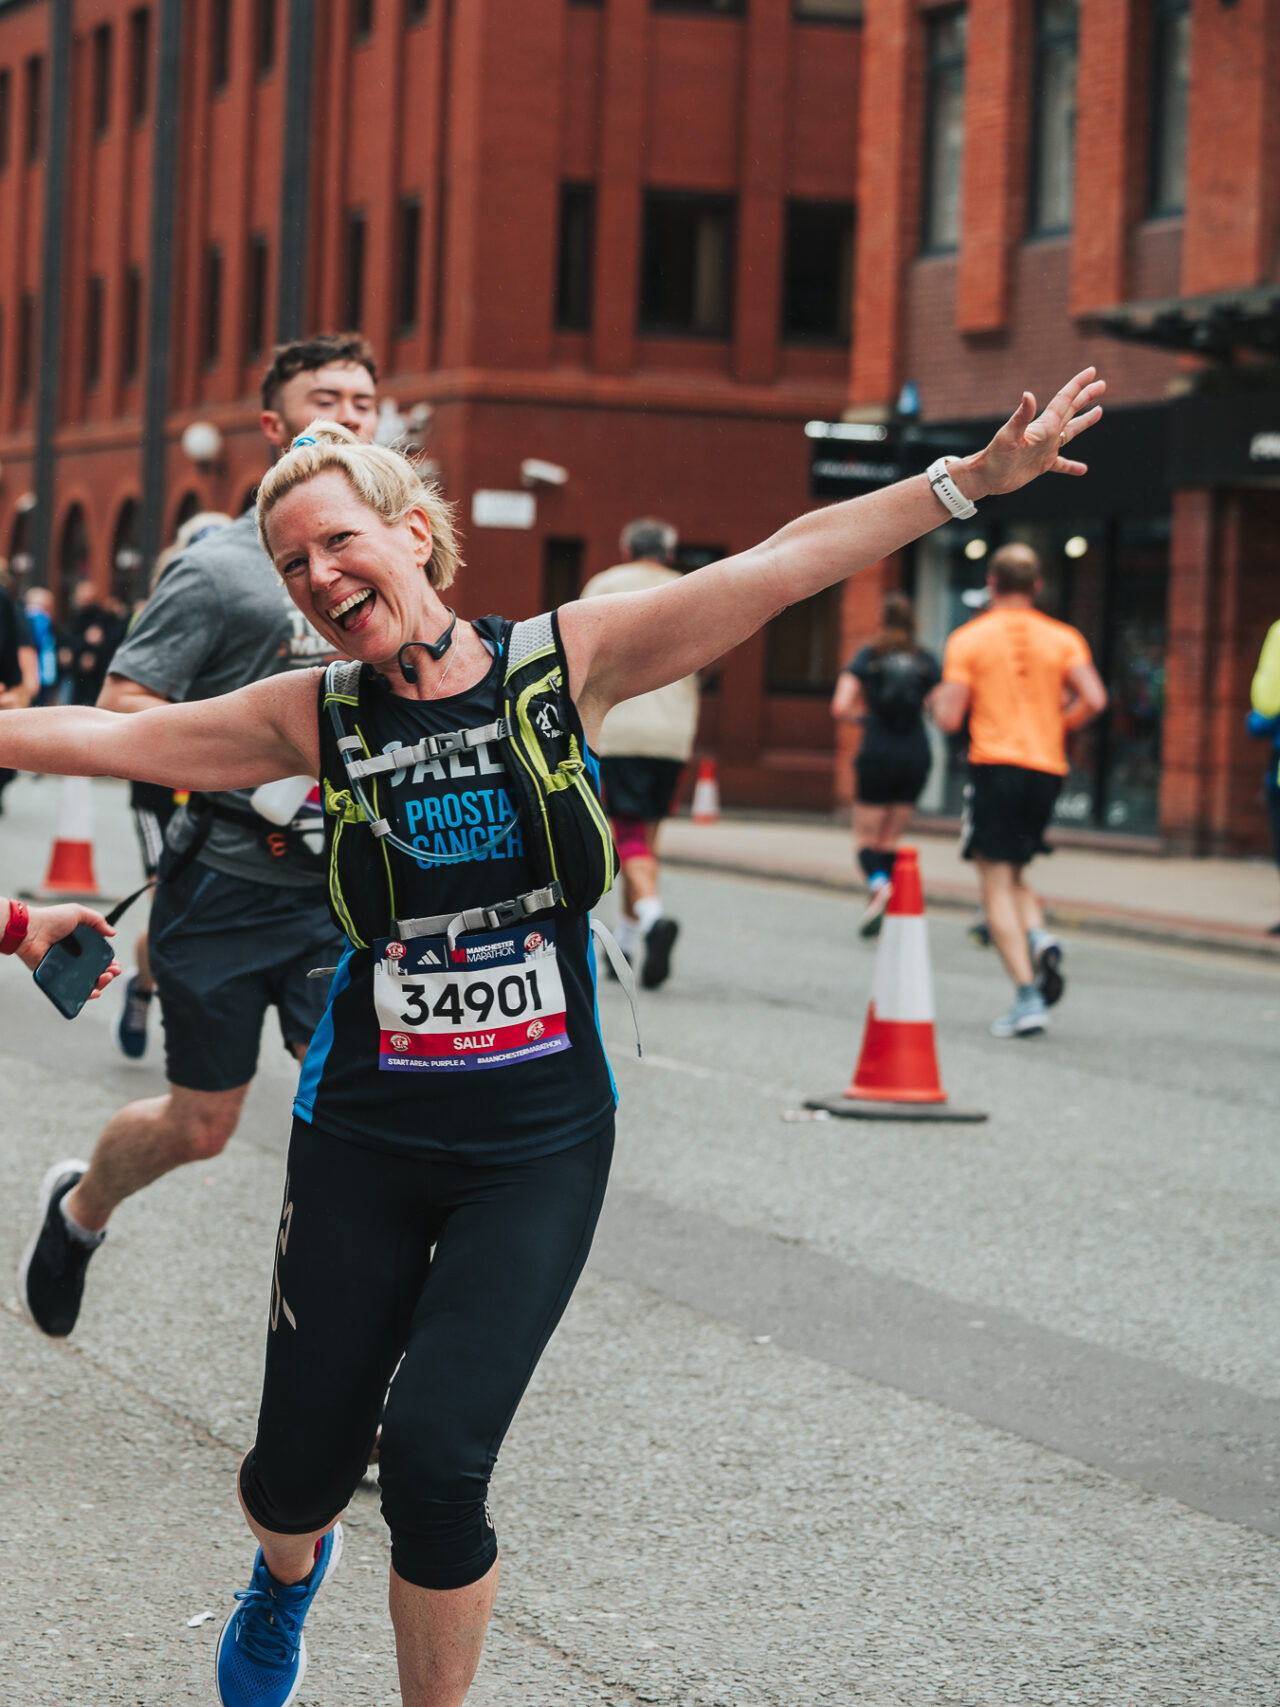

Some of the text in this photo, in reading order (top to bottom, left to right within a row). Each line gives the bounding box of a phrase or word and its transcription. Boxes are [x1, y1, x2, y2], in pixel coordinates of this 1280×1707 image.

[404, 787, 519, 835] PROSTA
[466, 940, 515, 954] MANCHESTER
[466, 947, 516, 963] MARATHON
[400, 969, 543, 1026] 34901
[453, 1033, 496, 1050] SALLY
[477, 1038, 562, 1064] #MANCHESTERMARATHON
[387, 1057, 409, 1066] START
[431, 1059, 459, 1067] PURPLE
